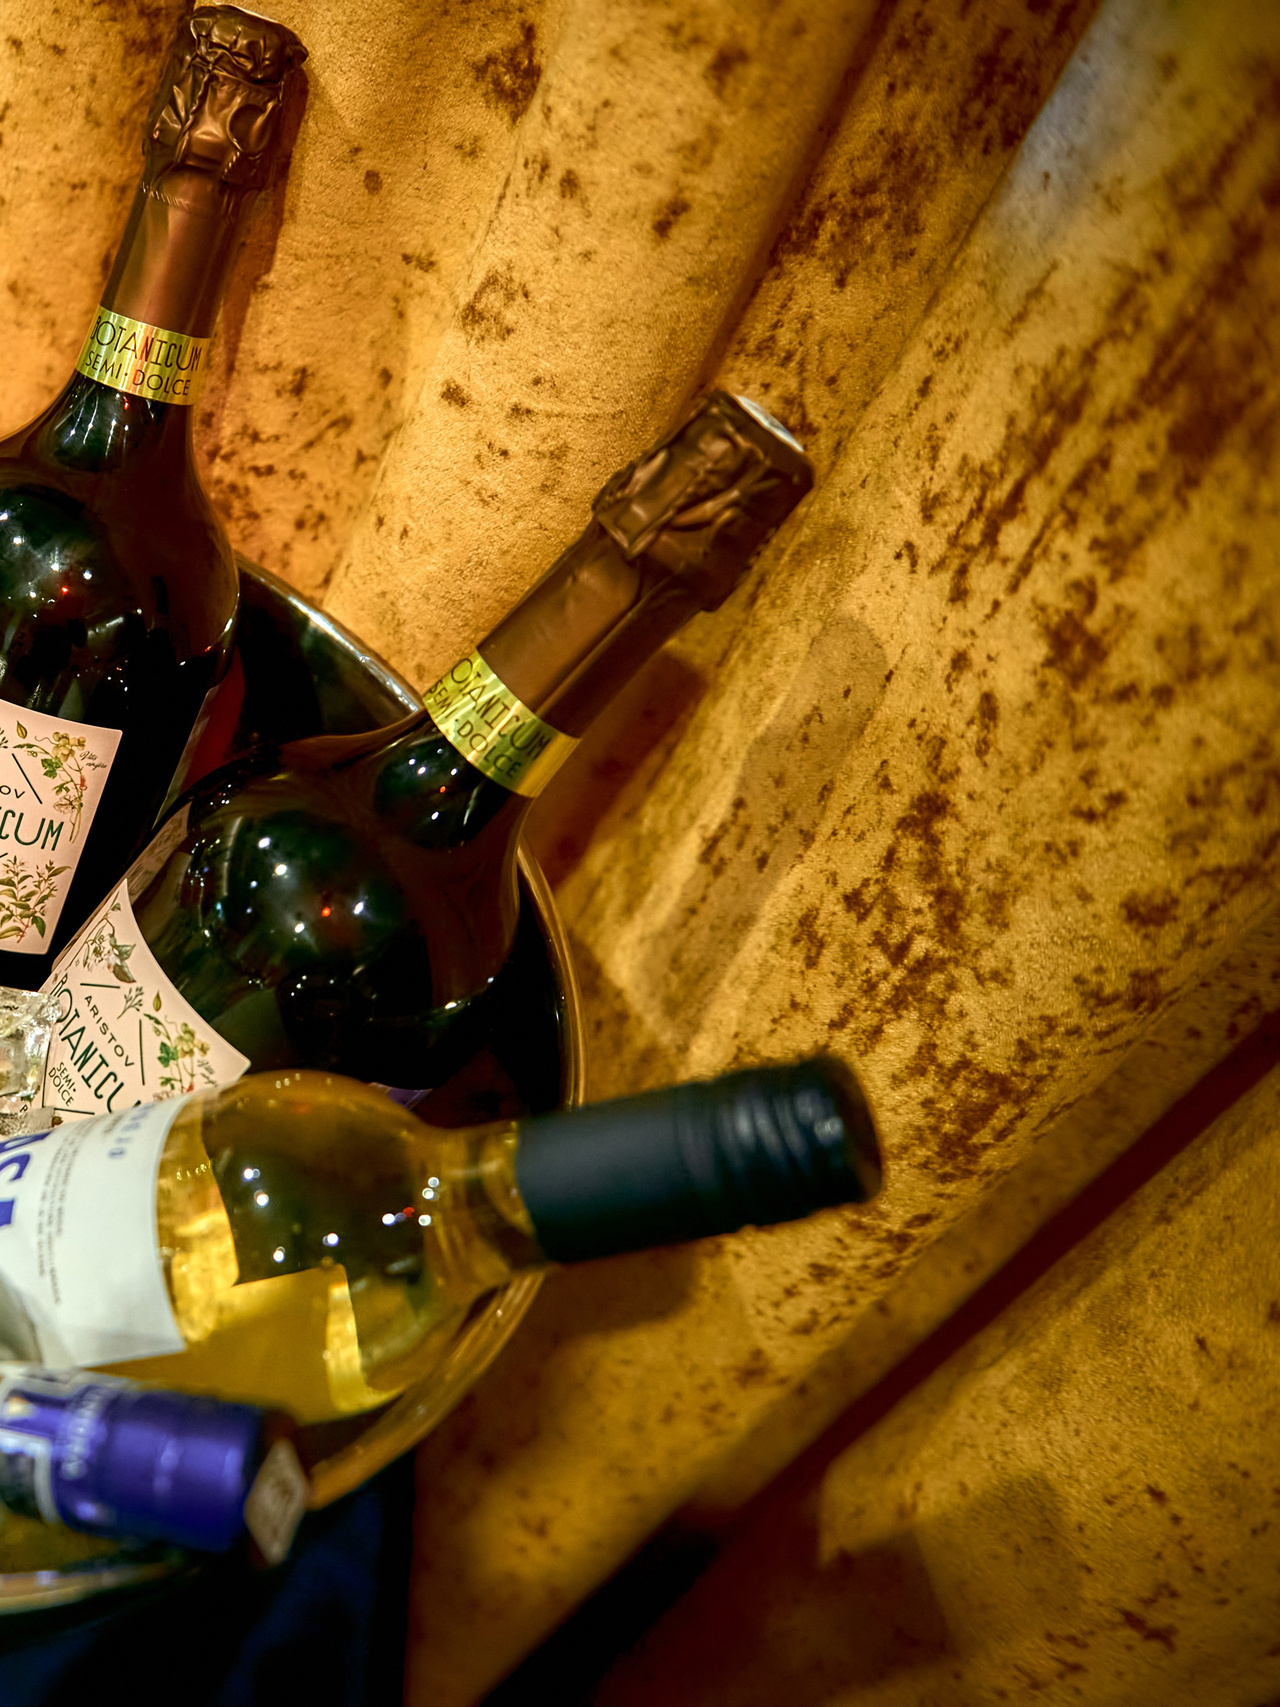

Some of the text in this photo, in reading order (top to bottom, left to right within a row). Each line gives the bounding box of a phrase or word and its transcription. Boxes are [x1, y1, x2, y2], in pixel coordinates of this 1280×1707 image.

[90, 315, 202, 372] BOTANICUM
[132, 369, 192, 396] DOLCE
[457, 719, 522, 780] DOLCE
[84, 995, 135, 1068] ARISTOV
[48, 1067, 75, 1107] DOLCE
